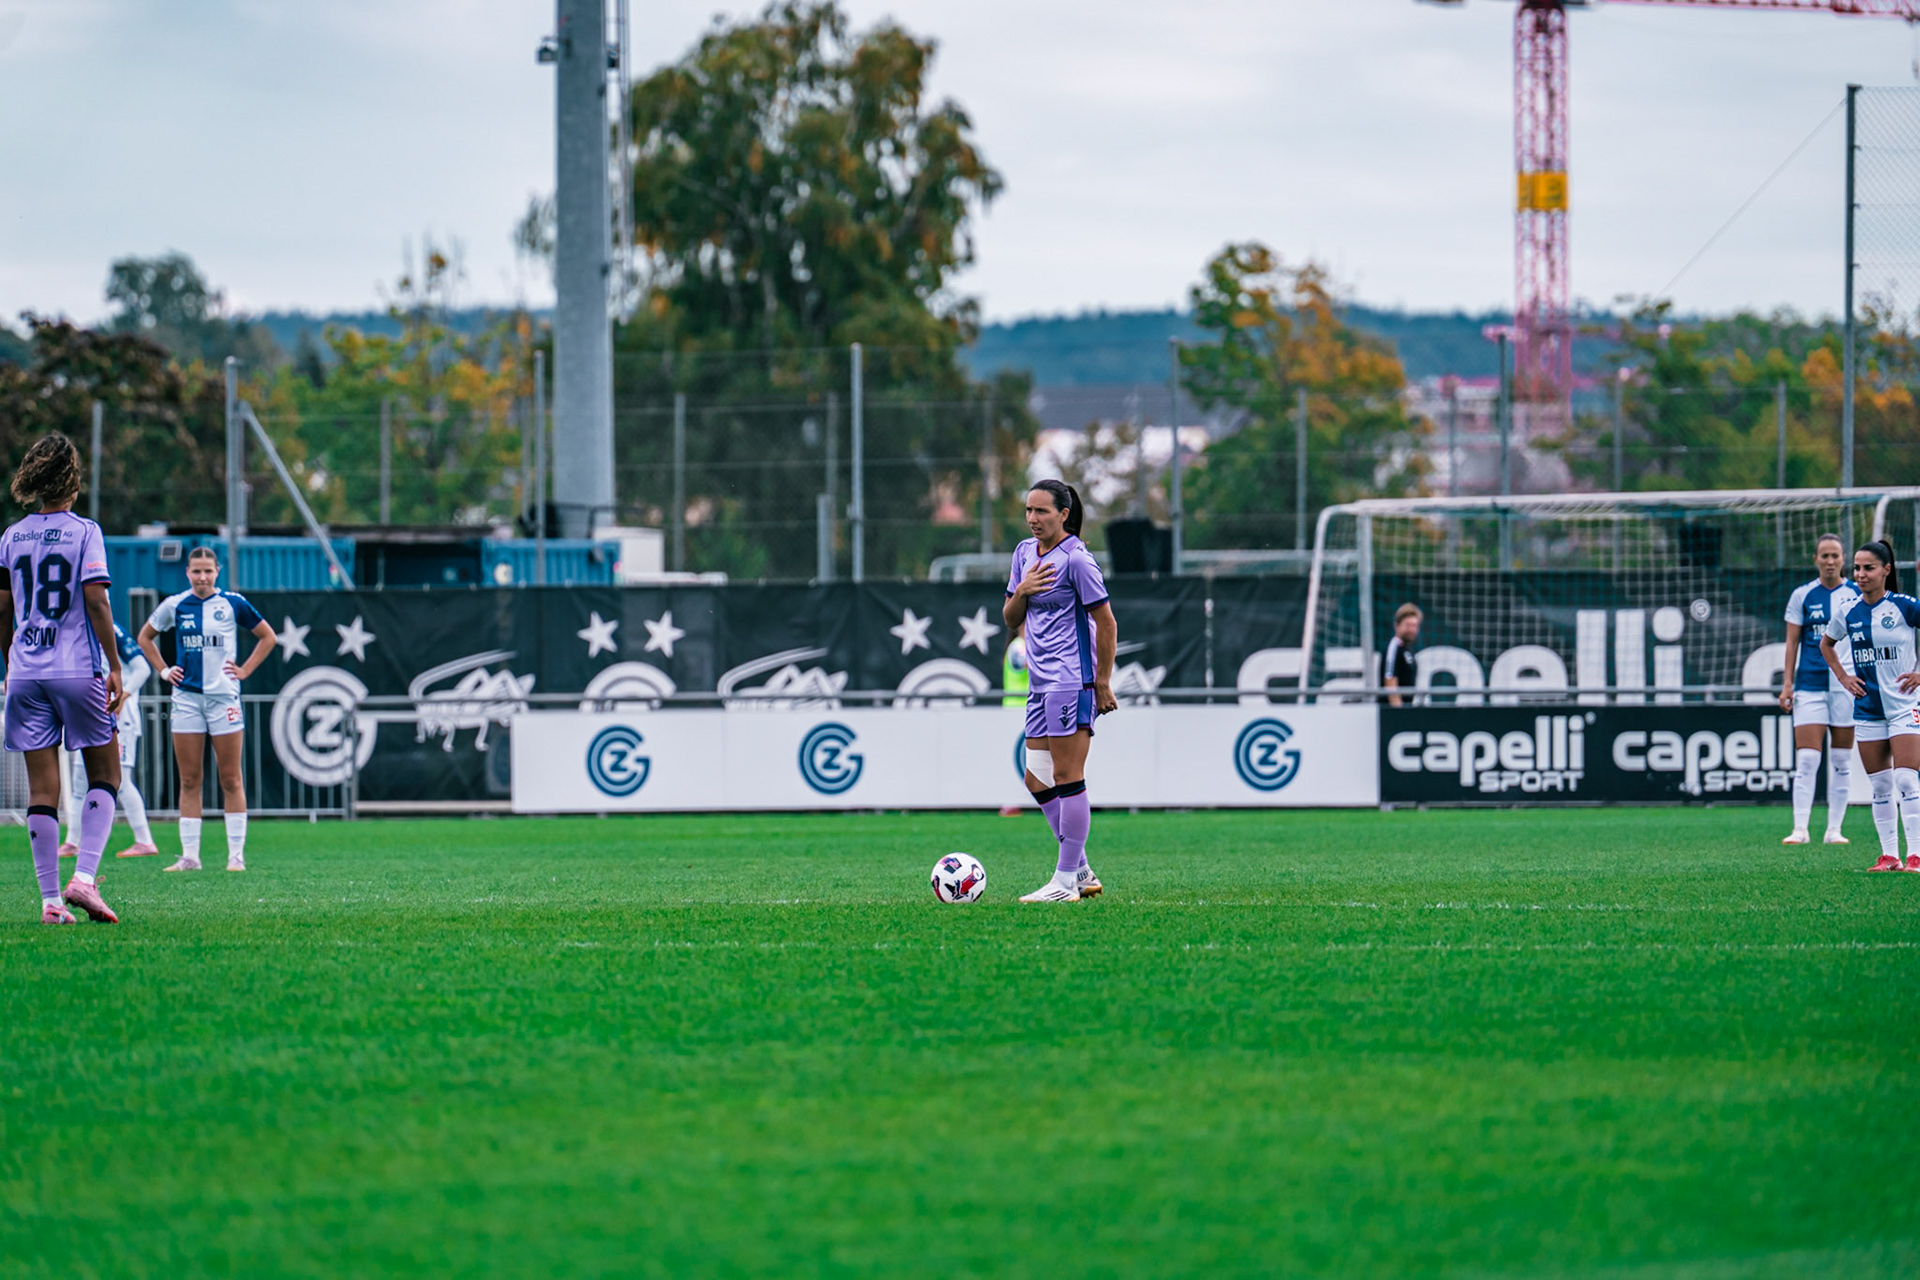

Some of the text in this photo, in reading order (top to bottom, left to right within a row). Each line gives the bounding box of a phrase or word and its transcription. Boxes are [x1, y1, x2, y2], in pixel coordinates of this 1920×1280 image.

[13, 530, 43, 543] Basler
[14, 553, 71, 621] 18
[25, 627, 56, 646] SOW
[1061, 705, 1069, 715] 9
[1387, 715, 1585, 786] capelli
[1612, 715, 1794, 790] capell
[1479, 771, 1585, 792] SPORT
